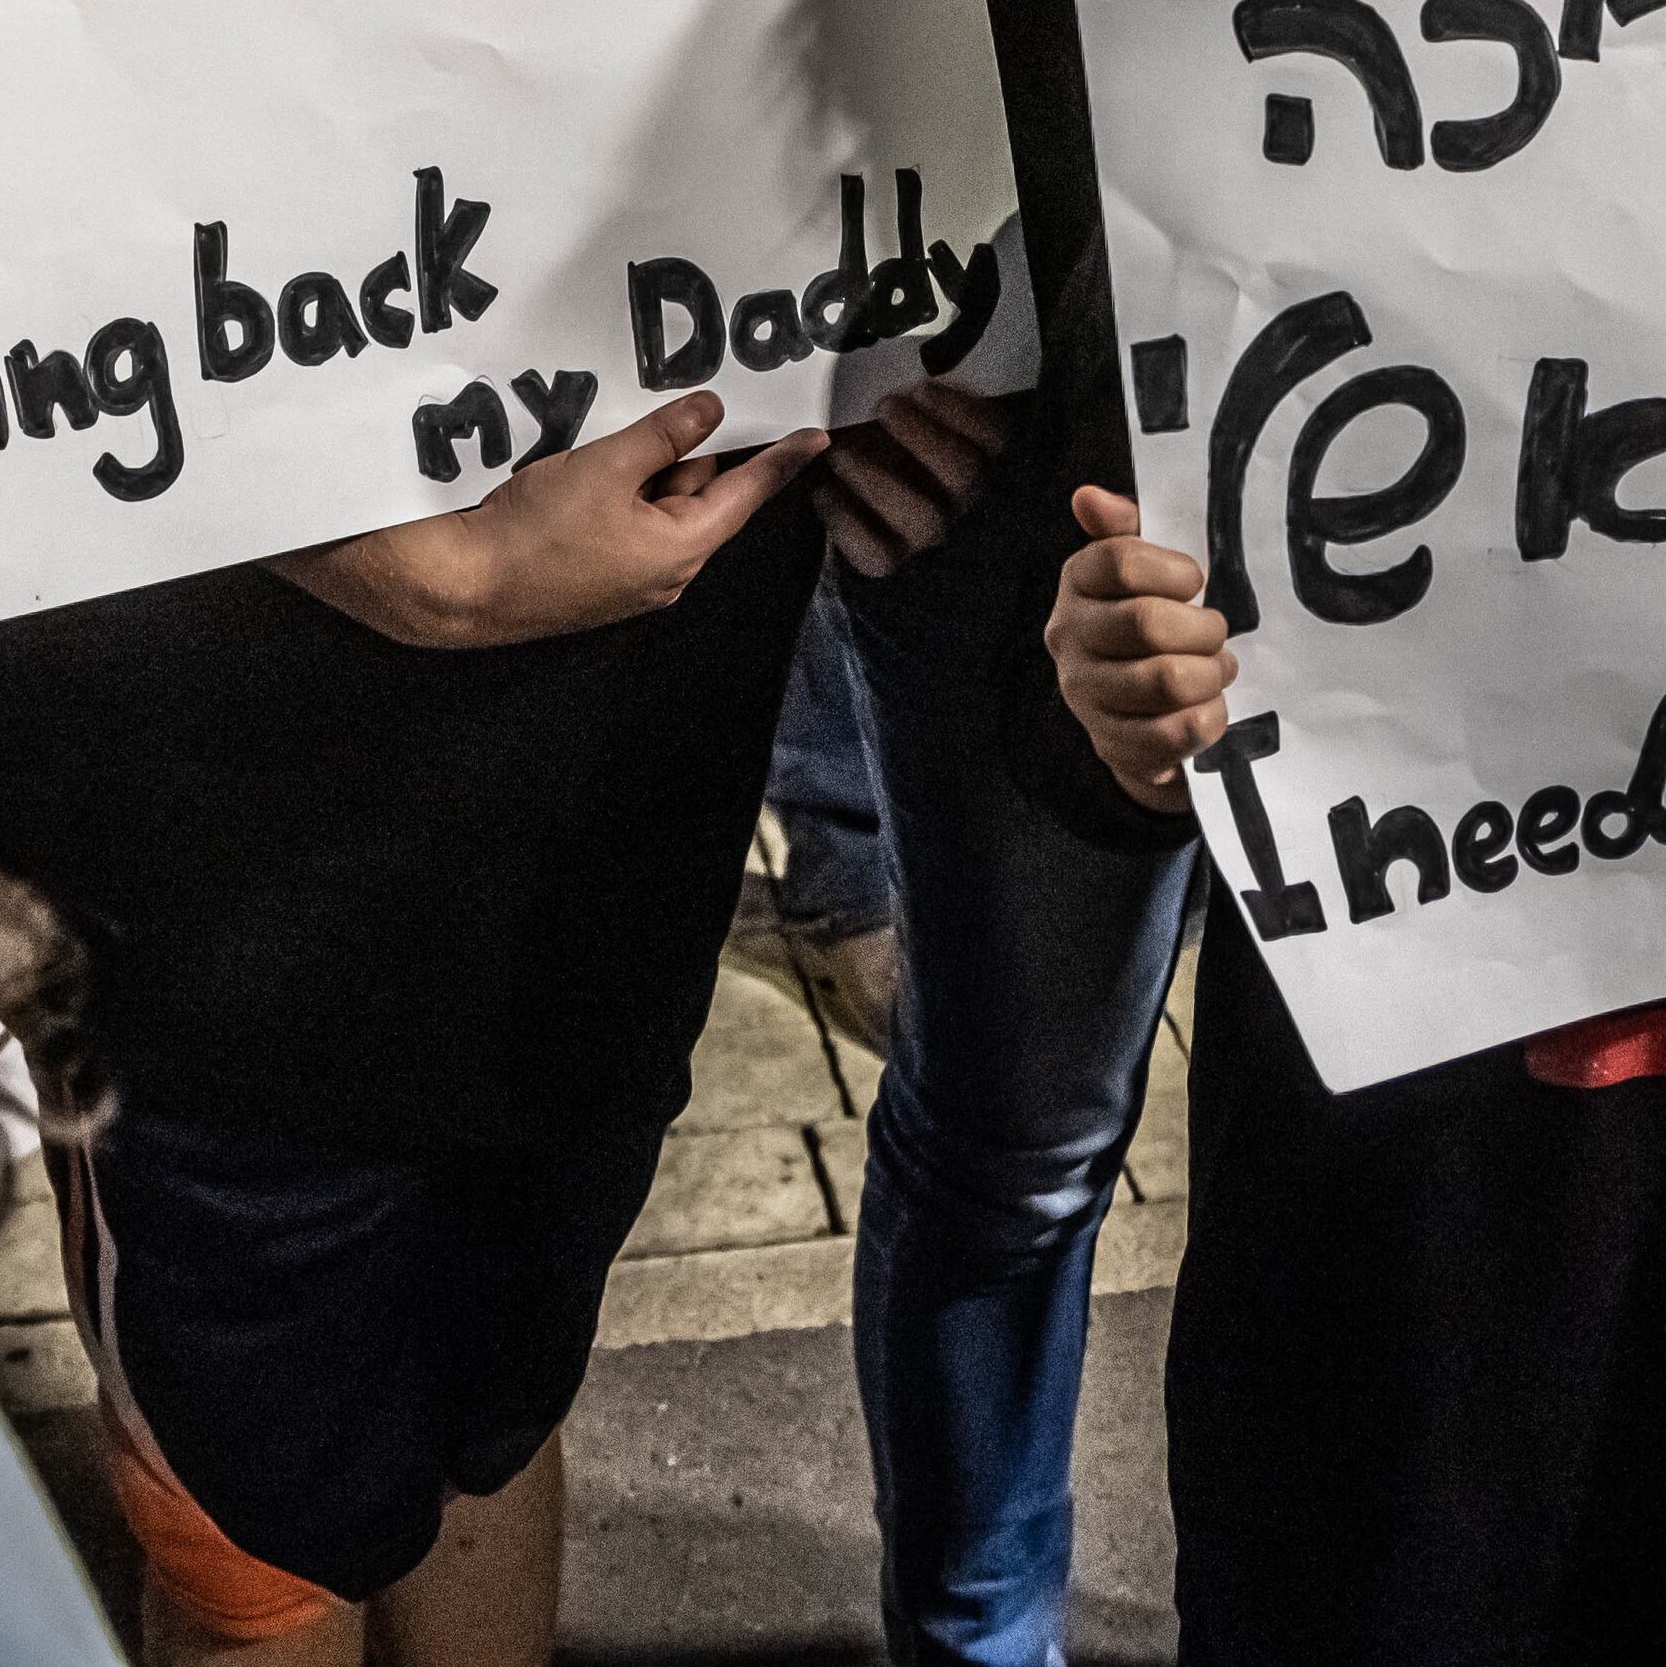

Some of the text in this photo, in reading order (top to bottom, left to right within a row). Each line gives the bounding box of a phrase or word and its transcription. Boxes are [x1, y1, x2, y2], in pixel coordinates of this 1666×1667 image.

[194, 165, 499, 383] back
[411, 368, 599, 483] my
[627, 165, 1002, 391] Daddy
[1194, 711, 1328, 942] I
